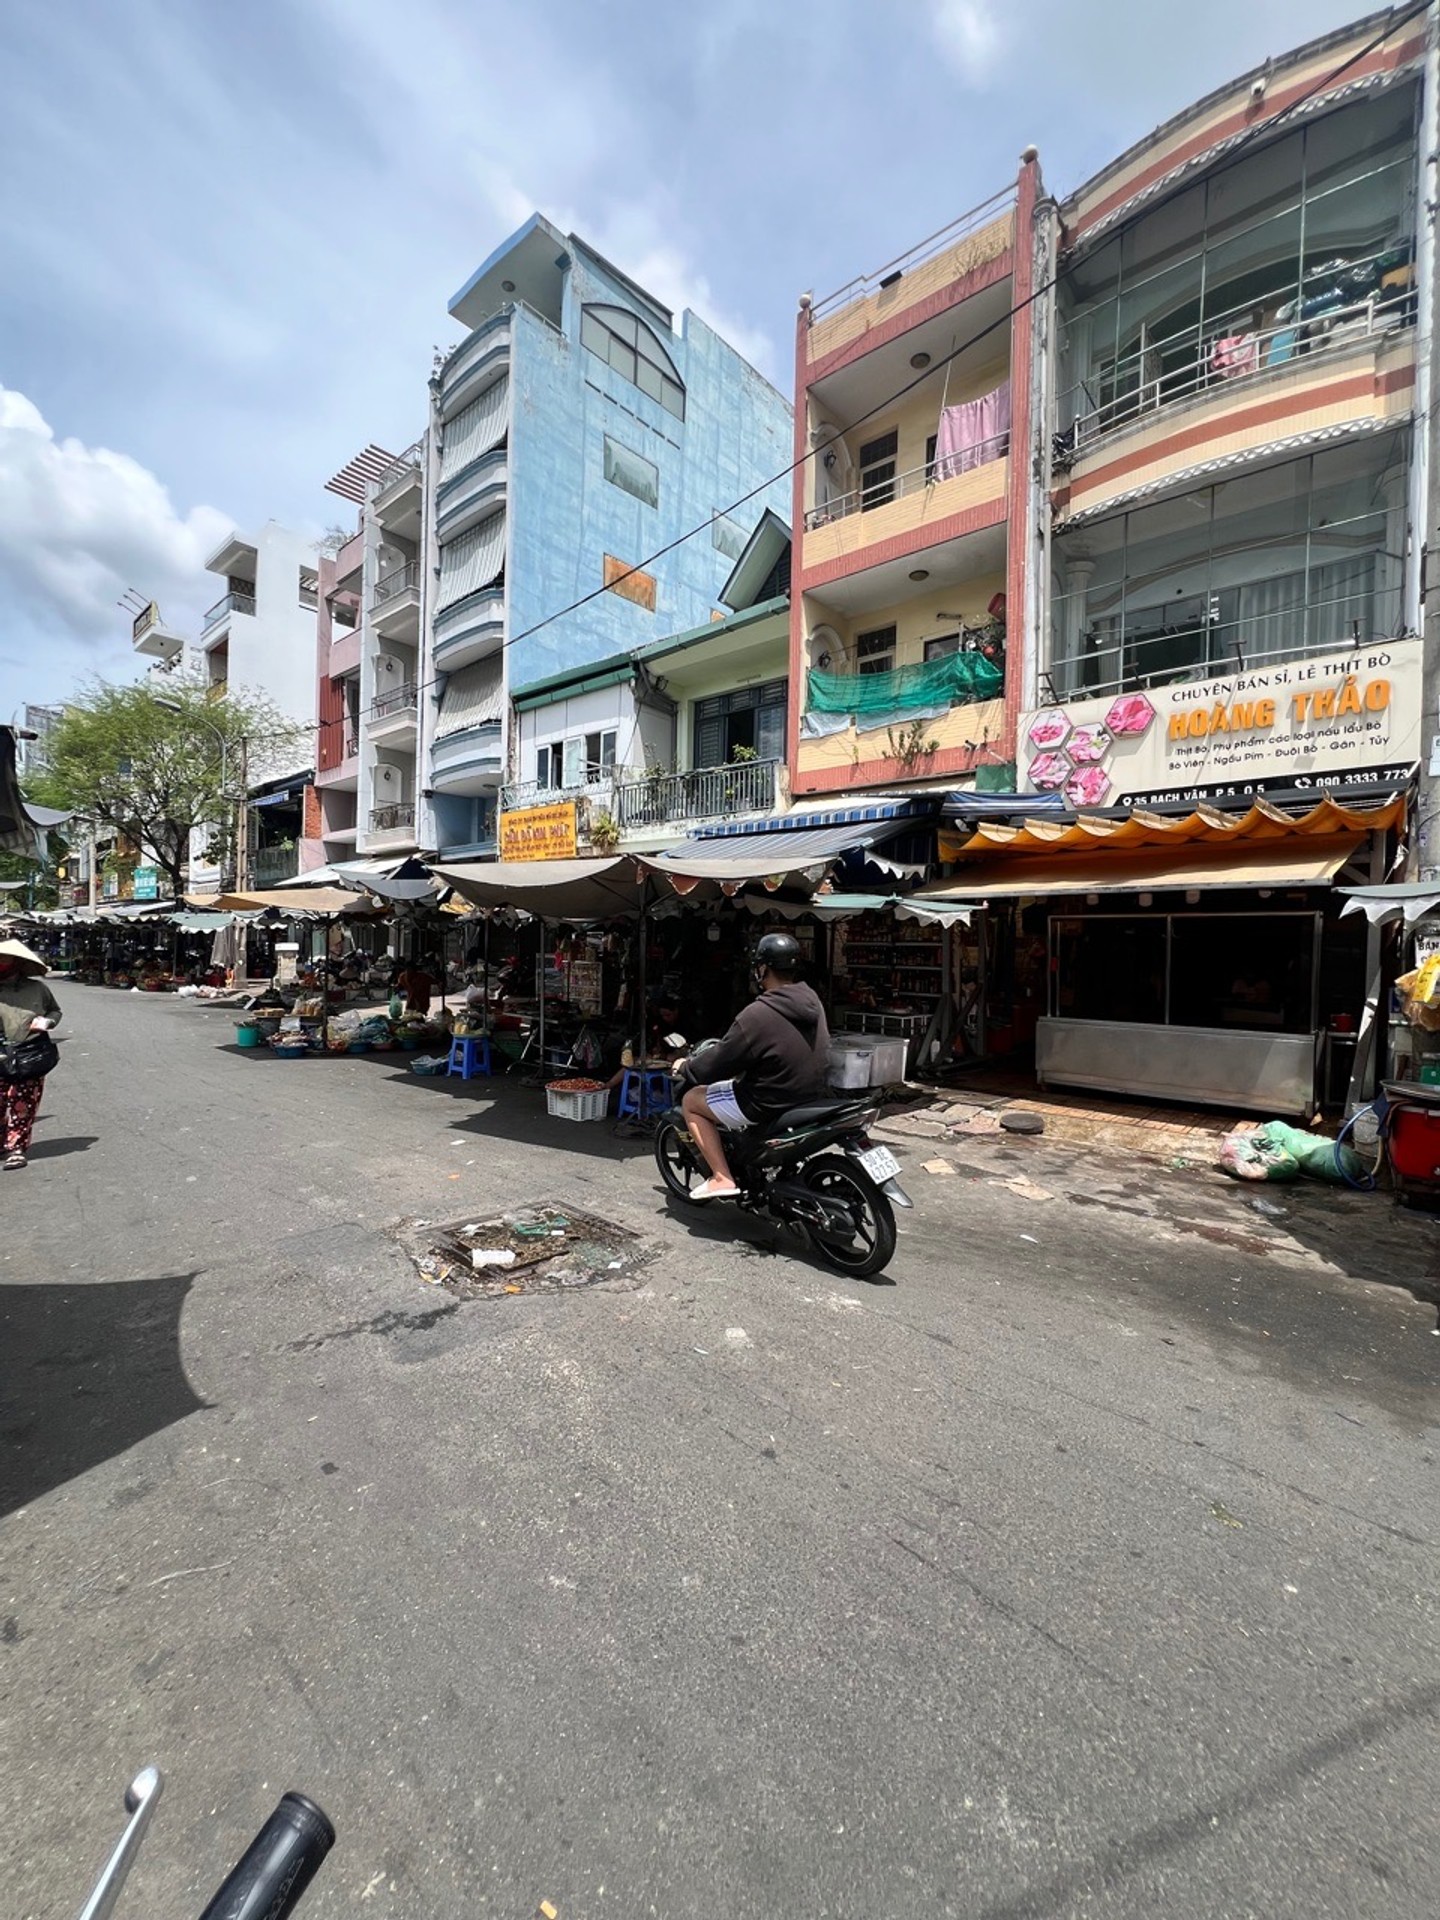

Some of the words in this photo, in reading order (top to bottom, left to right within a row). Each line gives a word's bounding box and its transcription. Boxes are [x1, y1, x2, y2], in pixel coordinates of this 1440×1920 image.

[1171, 682, 1232, 702] CHUYÊN
[1237, 675, 1269, 691] BÁN
[1298, 664, 1317, 681] LẺ
[1323, 659, 1362, 676] THỊT
[1368, 652, 1392, 669] BÒ
[1169, 699, 1276, 741] HOÀNG
[1291, 674, 1391, 723] THẢO
[1176, 748, 1193, 757] Thịt
[1268, 735, 1290, 744] các
[1293, 730, 1315, 741] loại
[1366, 720, 1382, 731] Bò
[1183, 759, 1205, 768] Viên
[1275, 746, 1300, 758] Đuôi
[1303, 744, 1318, 754] Bò
[1183, 789, 1208, 801] VÂN
[1315, 776, 1341, 788] 090
[1344, 772, 1379, 785] 3333
[1383, 769, 1409, 781] 773
